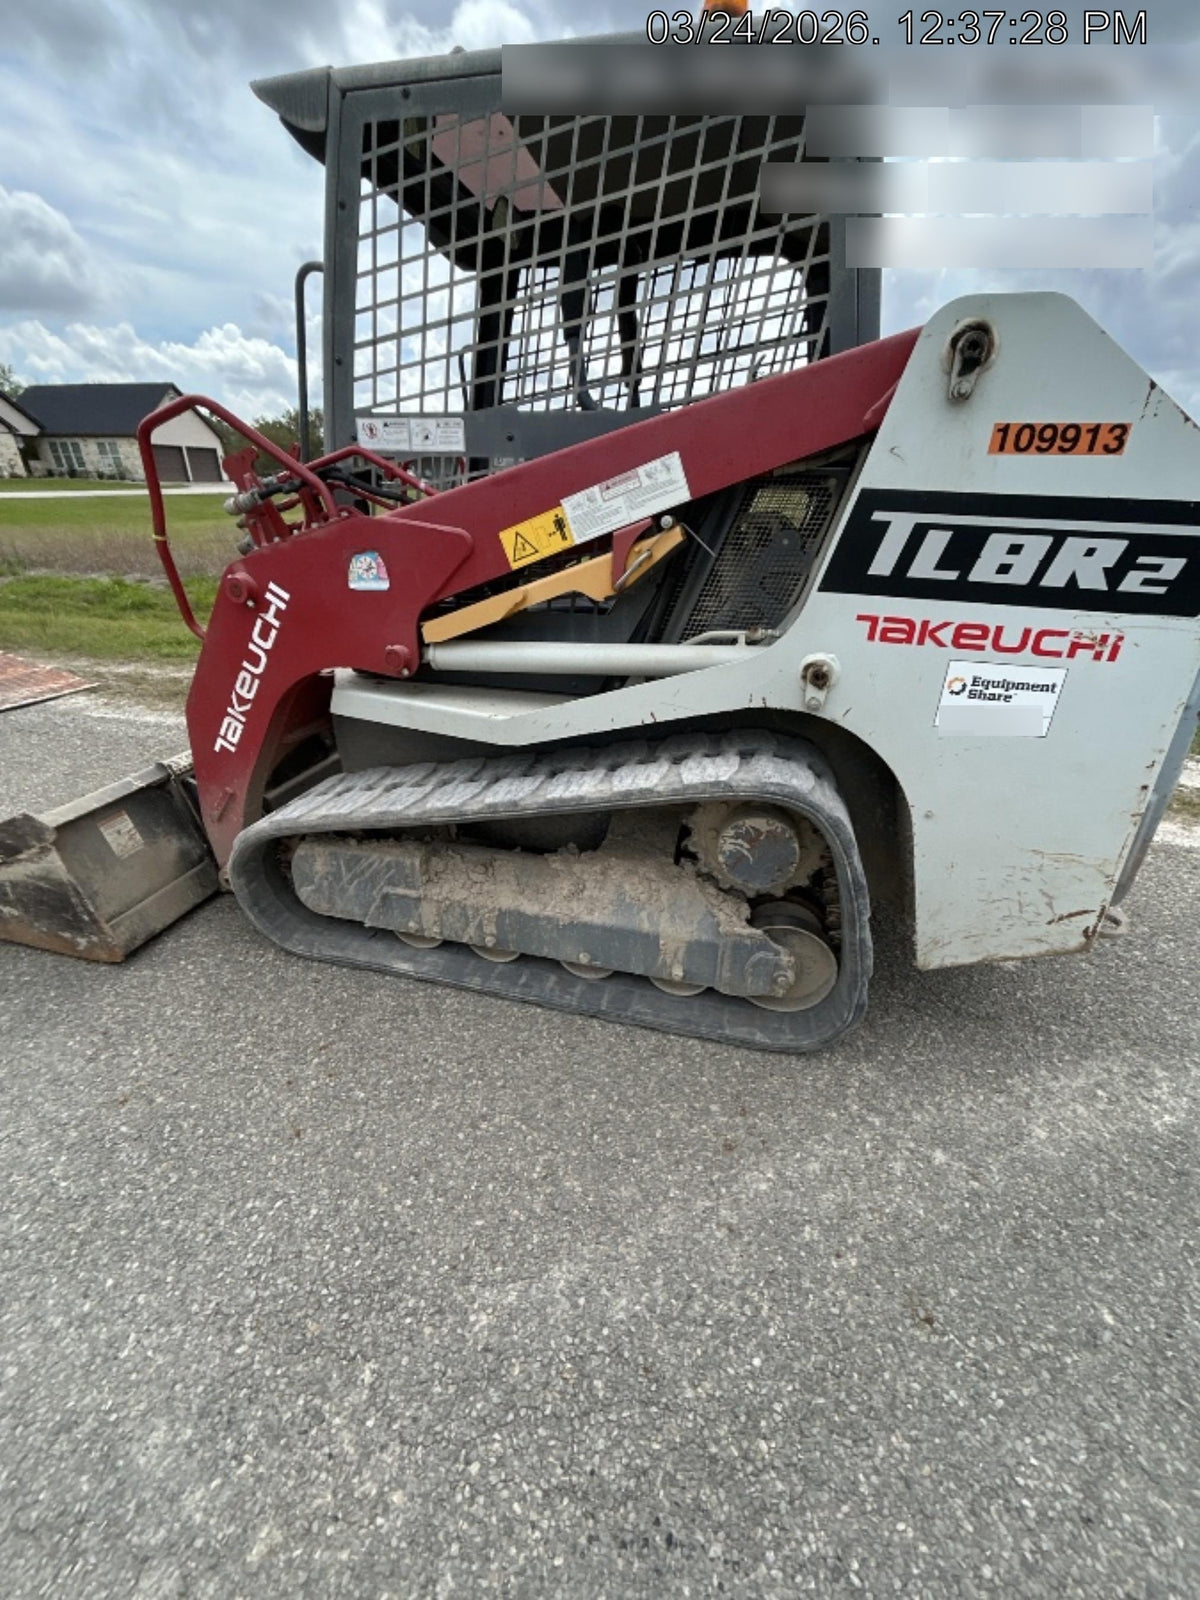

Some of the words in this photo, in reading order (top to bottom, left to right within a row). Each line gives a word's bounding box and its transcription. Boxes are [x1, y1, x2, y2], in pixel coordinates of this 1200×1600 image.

[994, 422, 1129, 454] 109913
[970, 675, 1058, 694] Equipment
[967, 688, 1013, 703] Share
